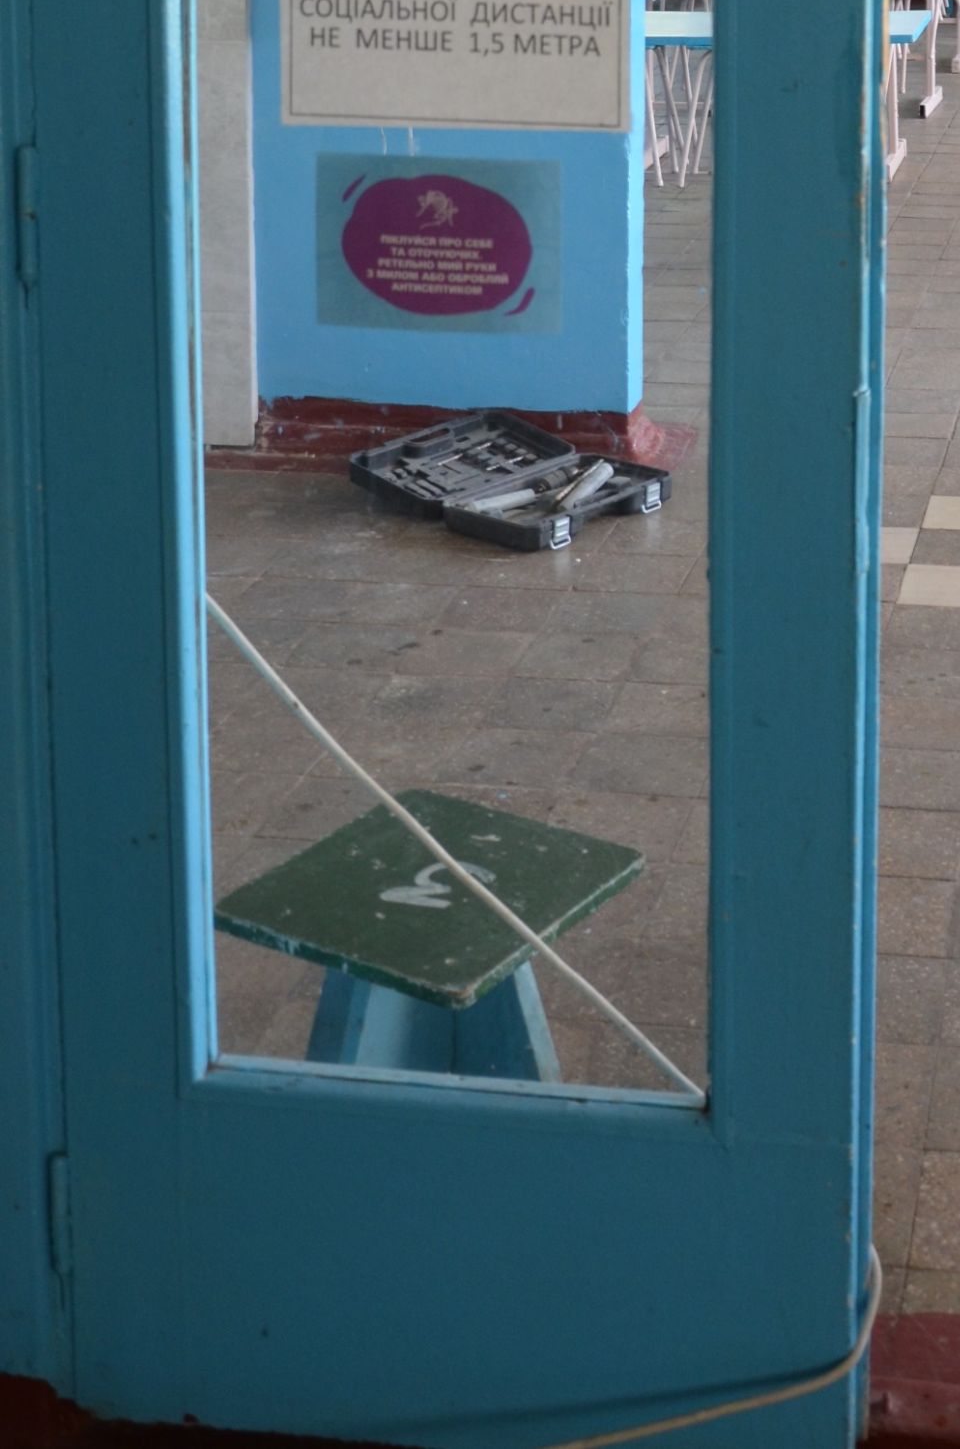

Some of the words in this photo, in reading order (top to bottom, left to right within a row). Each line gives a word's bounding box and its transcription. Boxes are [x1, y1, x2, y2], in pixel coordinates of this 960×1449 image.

[470, 0, 614, 30] ДИСТАНЦІЇ
[309, 26, 341, 49] НЕ
[356, 29, 453, 52] МЕНШЕ
[469, 32, 504, 57] 1,5
[513, 34, 601, 57] МЕТРА
[390, 247, 406, 257] ТА
